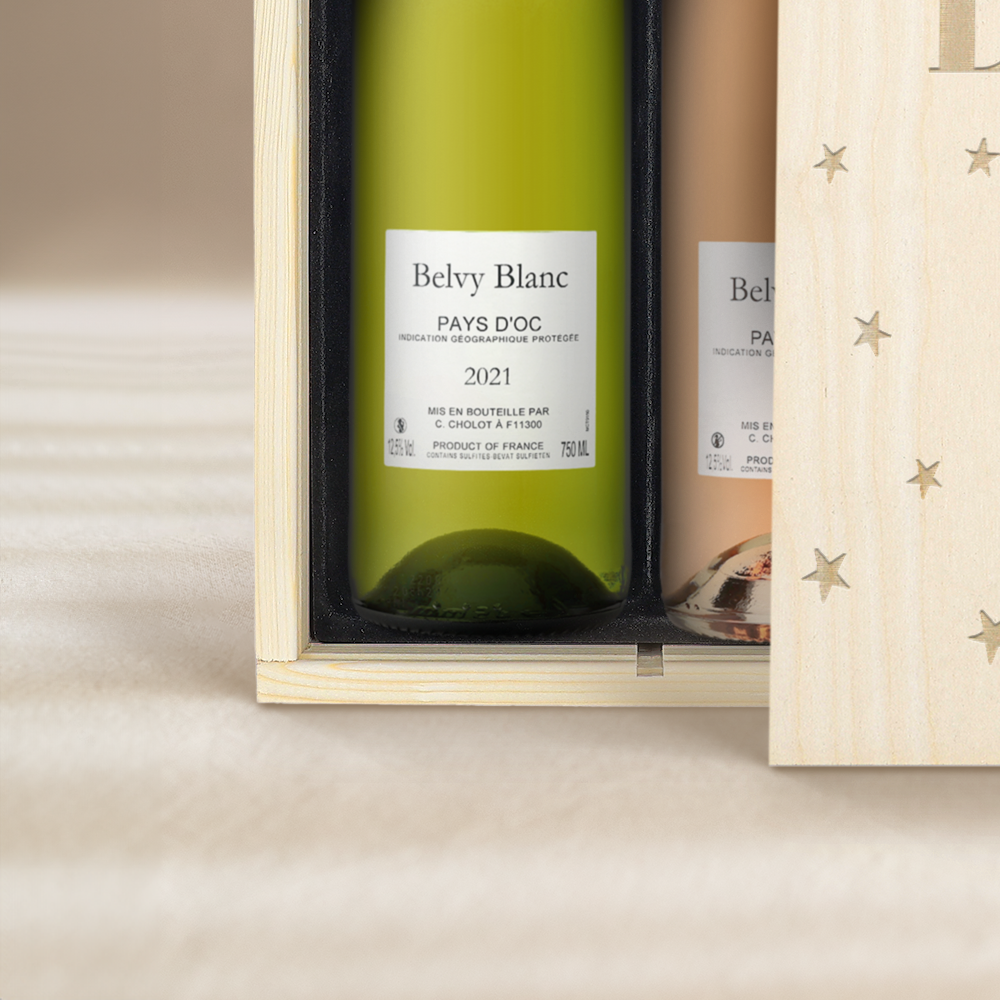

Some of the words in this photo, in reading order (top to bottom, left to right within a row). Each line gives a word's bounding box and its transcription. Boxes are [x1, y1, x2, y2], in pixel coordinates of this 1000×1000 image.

[412, 262, 485, 297] Belvy
[494, 263, 569, 289] Blanc
[437, 315, 488, 332] PAYS
[495, 315, 542, 332] D'OC
[398, 333, 448, 343] INDICATION
[450, 333, 529, 344] GÉOGRAPHIQUE
[712, 347, 762, 357] INDICATION
[464, 366, 511, 386] 2021
[427, 406, 446, 416] MIS
[449, 407, 463, 416] EN
[466, 407, 526, 417] BOUTEILLE
[528, 406, 550, 416] PAR
[435, 419, 445, 429] C.
[448, 420, 492, 430] CHOLOT
[495, 418, 504, 429] À
[506, 420, 543, 430] F11300
[741, 421, 759, 431] MIS
[748, 433, 759, 443] C.
[433, 441, 481, 451] PRODUCT
[485, 442, 499, 451] OF
[503, 442, 544, 451] FRANCE
[561, 441, 577, 458] 750
[426, 451, 457, 460] CONTAINS
[516, 451, 551, 459] SULFIETEN
